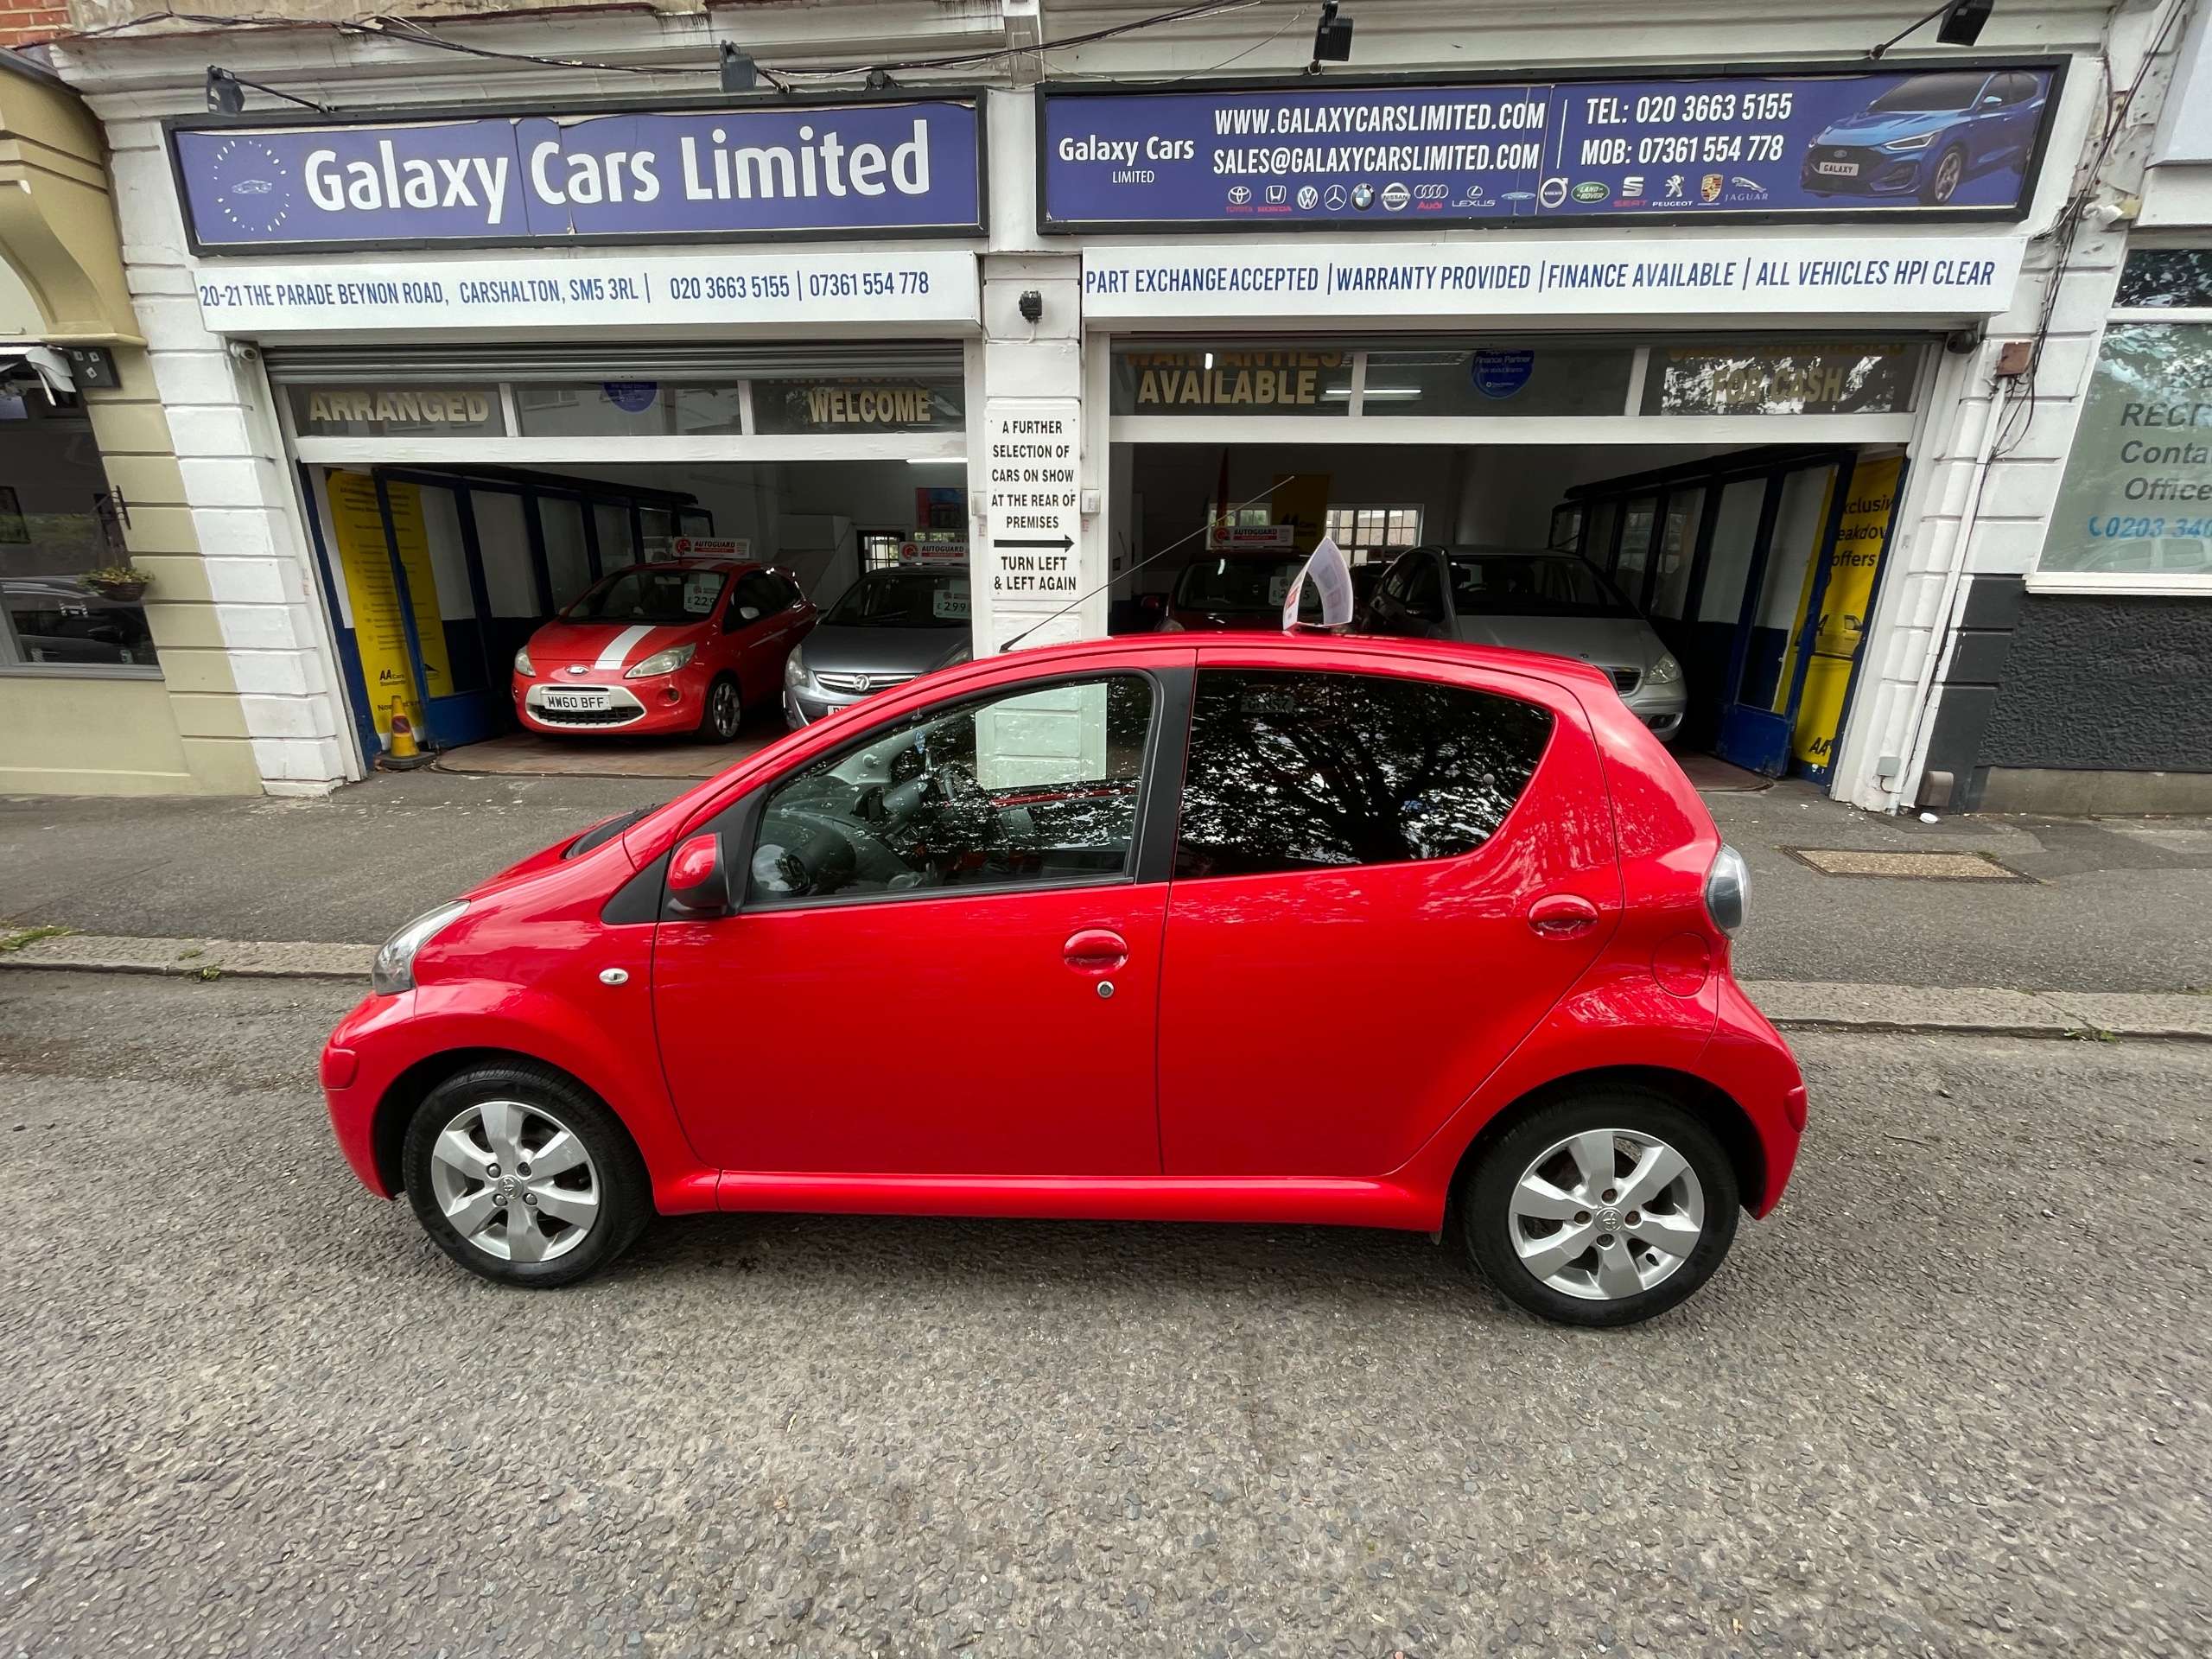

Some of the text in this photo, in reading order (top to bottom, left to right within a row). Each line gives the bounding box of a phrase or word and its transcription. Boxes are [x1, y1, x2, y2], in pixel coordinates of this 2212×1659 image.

[1215, 103, 1545, 135] WWW.GALAXYCARSLIMITED.COM
[1586, 93, 1792, 124] TEL: 020 3663 5155
[1059, 135, 1194, 167] Galaxy Cars
[1213, 144, 1540, 175] SALES@GALAXYCARSLIMITED.COM
[1581, 135, 1783, 166] MOB: 07361 554 778
[304, 119, 931, 224] Galaxy Cars Limited
[1113, 170, 1154, 184] LIMITED
[1822, 164, 1853, 174] GALAXY
[1417, 201, 1443, 210] Audi
[1726, 193, 1769, 201] JAGUAR
[810, 271, 929, 296] 07361 554 778
[1085, 268, 1319, 294] PART EXCHANGE ACCEPTED
[1337, 265, 1530, 291] WARRANTY PROVIDED
[1548, 262, 1736, 289] FINANCE AVAILABLE
[1756, 261, 1995, 287] ALL VEHICLES HPI CLEAR
[200, 278, 639, 308] 20-21 THE PARADE BEYNON ROAD, CARSHALTON, SM5 3RL
[671, 275, 790, 300] 020 3663 5155
[1137, 370, 1317, 404] AVAILABLE
[1713, 367, 1844, 403] FOR CASH
[309, 391, 489, 422] ARRANGED
[809, 390, 931, 423] WELCOME
[1002, 421, 1063, 434] A FURTHER
[993, 445, 1070, 458] SELECTION OF
[992, 469, 1074, 482] CARS ON SHOW
[991, 494, 1004, 506] AT
[1007, 494, 1027, 506] THE
[1032, 494, 1058, 506] REAR
[1062, 494, 1076, 506] OF
[1007, 516, 1058, 528] PREMISES
[2106, 517, 2164, 538] 0203
[1001, 556, 1067, 570] TURN LEFT
[1832, 550, 1876, 567] offers
[994, 576, 1077, 590] & LEFT AGAIN
[380, 669, 392, 680] AA
[547, 696, 605, 709] MW60 BFF
